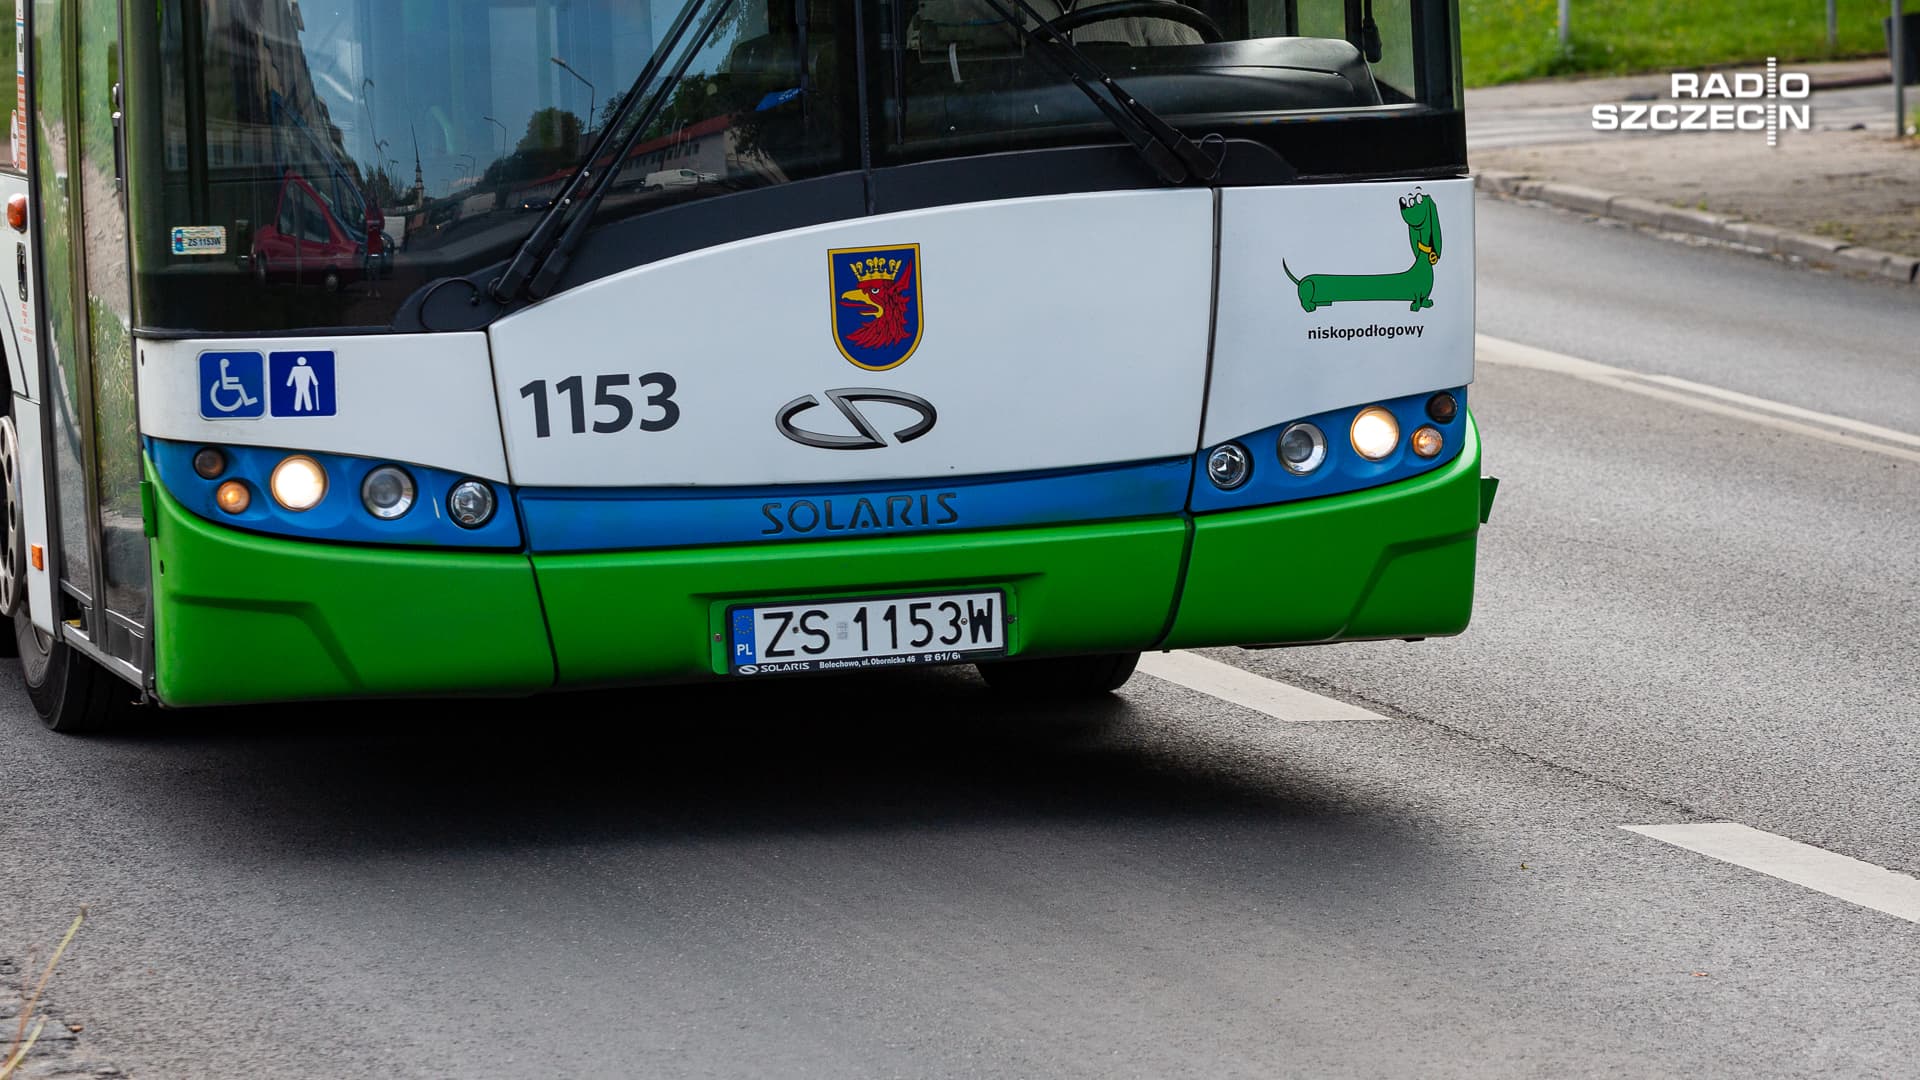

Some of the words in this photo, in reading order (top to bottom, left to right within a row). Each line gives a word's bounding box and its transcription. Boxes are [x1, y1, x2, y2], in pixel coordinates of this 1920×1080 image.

[1307, 324, 1425, 341] niskopodłogowy
[519, 371, 681, 438] 1153
[761, 493, 959, 535] SOLARIS
[762, 609, 831, 658] ZS
[852, 598, 994, 651] 1153W
[736, 643, 753, 657] PL
[760, 662, 810, 673] SOLARIS
[819, 660, 861, 669] Bolechowo,
[861, 658, 870, 666] ul.
[870, 656, 906, 666] Obornicka
